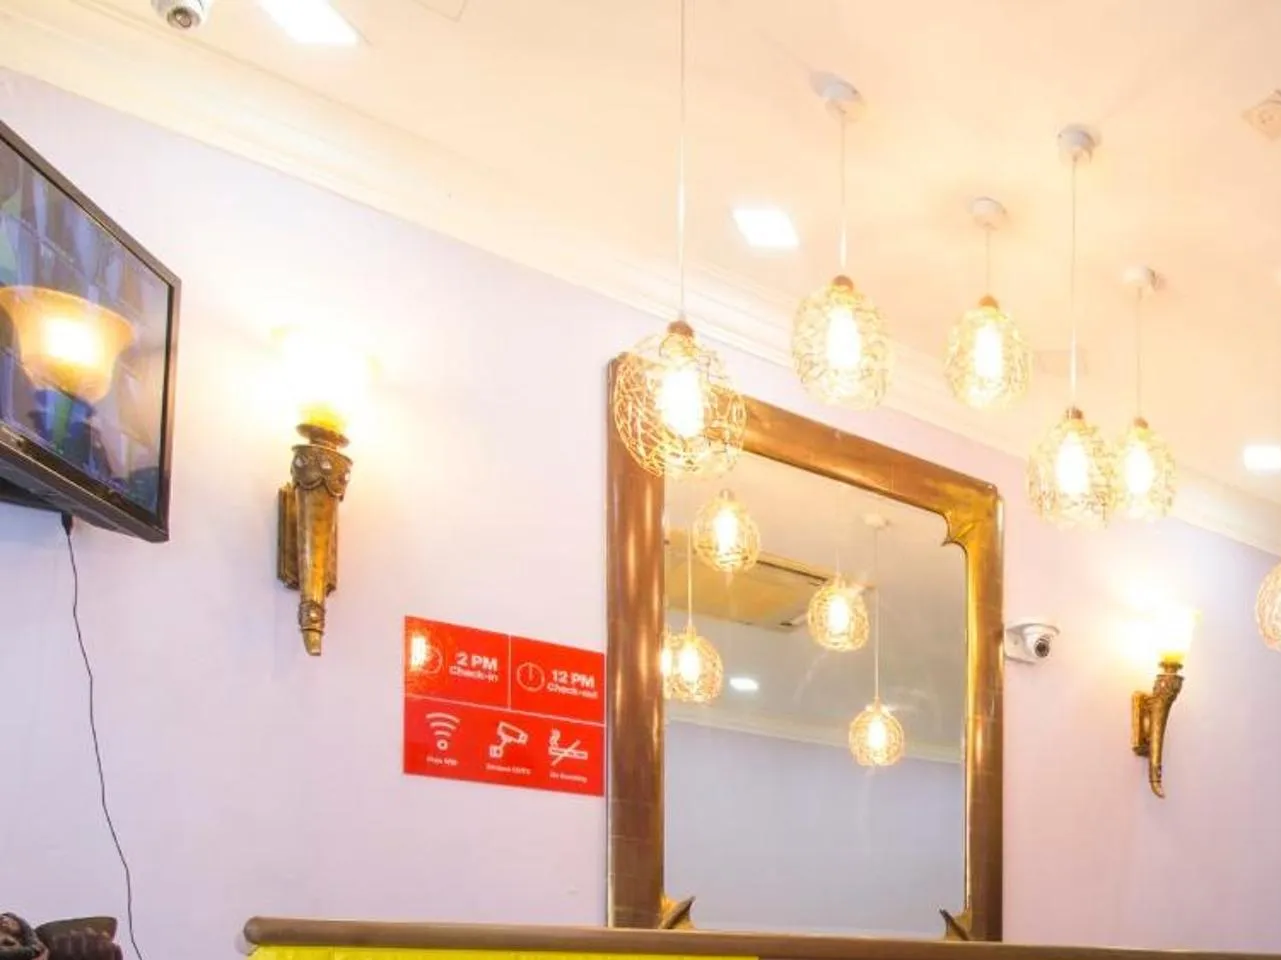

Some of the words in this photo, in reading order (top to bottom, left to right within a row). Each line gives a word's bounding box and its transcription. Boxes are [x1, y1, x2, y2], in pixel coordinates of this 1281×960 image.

[455, 651, 468, 667] 2
[471, 654, 498, 671] PM
[552, 669, 568, 684] 12
[571, 672, 595, 688] PM
